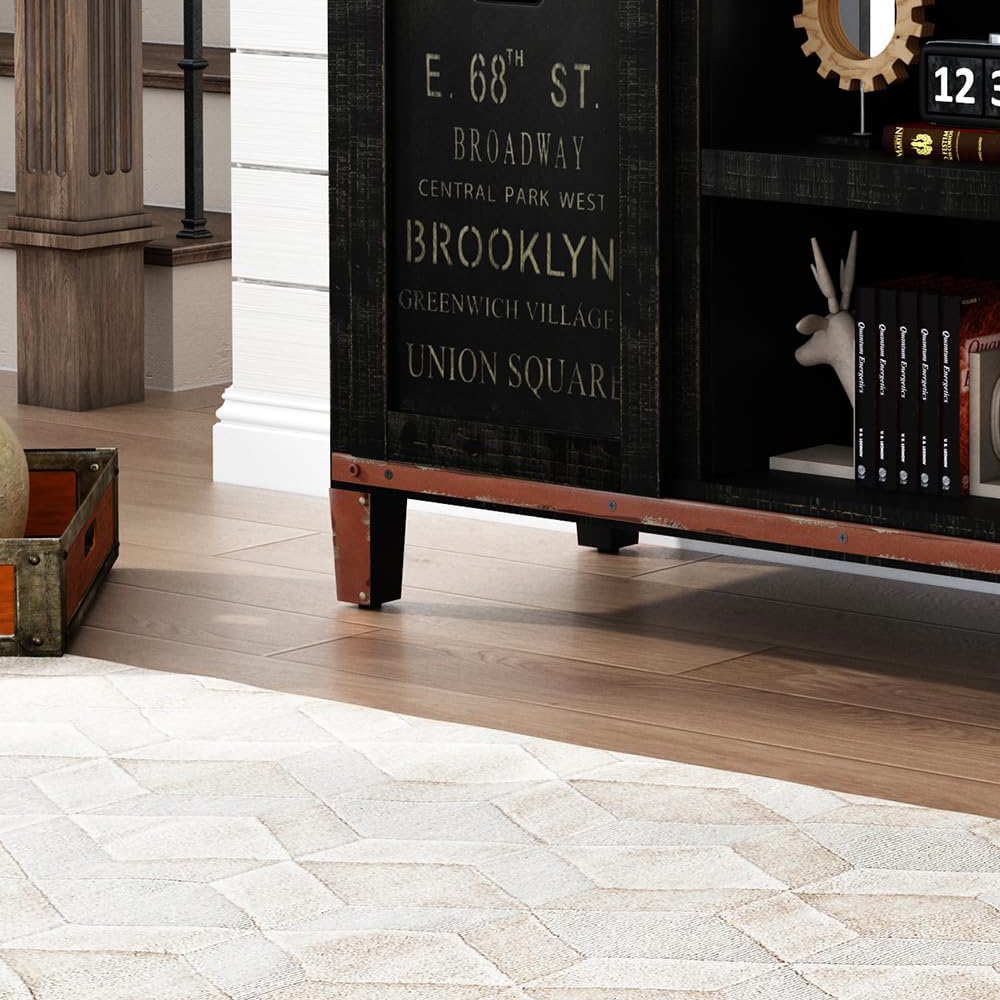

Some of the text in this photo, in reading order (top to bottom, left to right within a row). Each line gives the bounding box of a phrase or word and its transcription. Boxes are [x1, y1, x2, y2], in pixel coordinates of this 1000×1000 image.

[425, 53, 454, 99] E.
[550, 63, 600, 109] ST.
[934, 66, 976, 104] 12
[453, 126, 584, 170] BROADWAY
[418, 178, 606, 213] CENTRAL PARK WEST
[405, 218, 617, 282] BROOKLYN
[398, 288, 615, 331] GREENWICH VILLAGE
[405, 343, 498, 386] UNION
